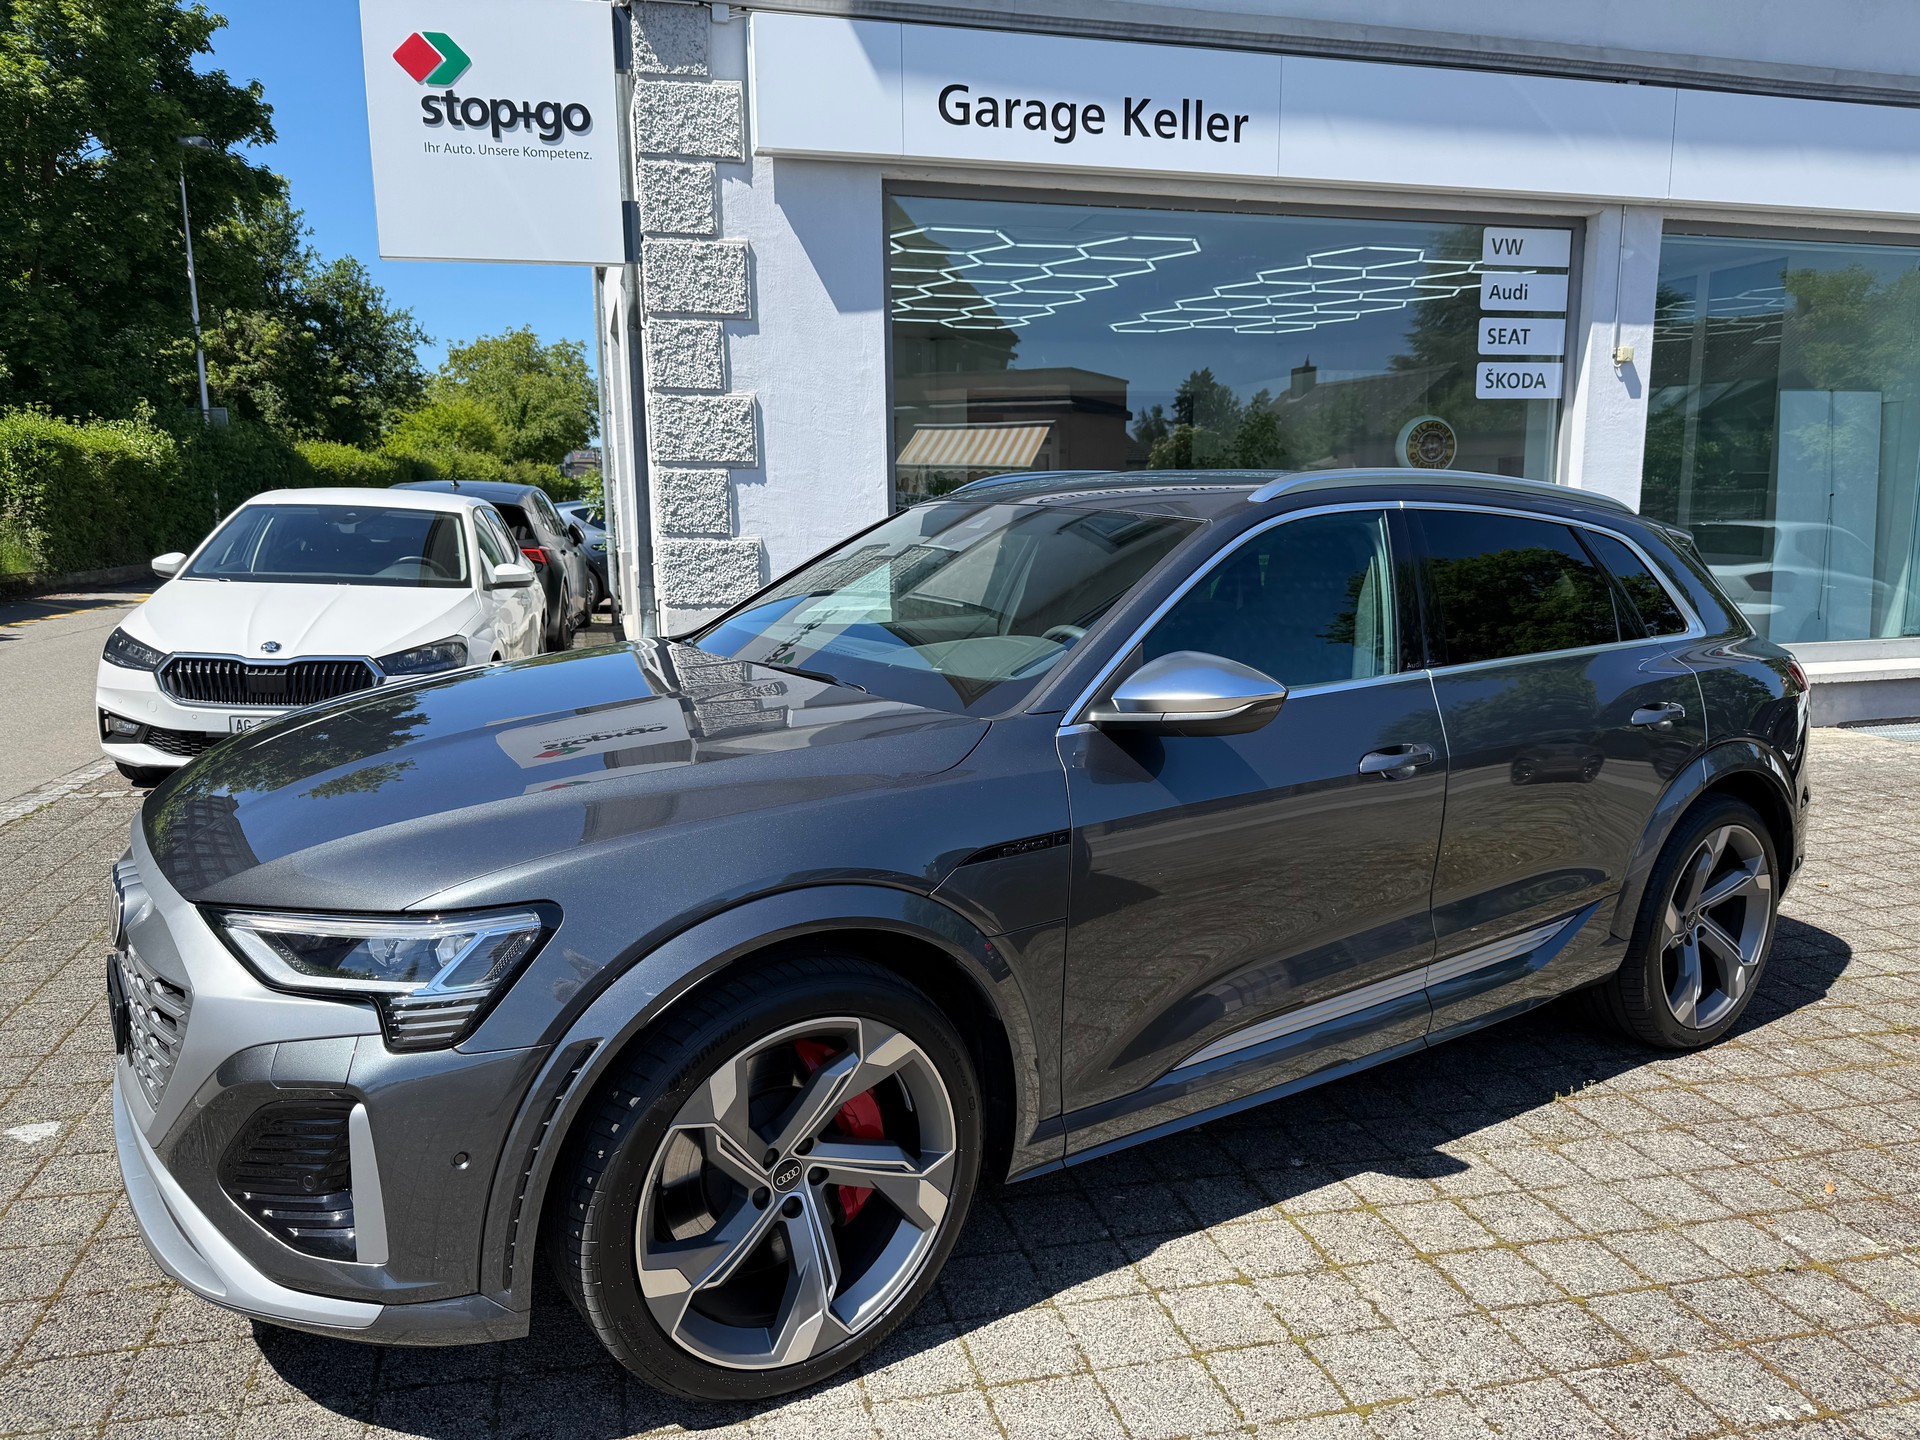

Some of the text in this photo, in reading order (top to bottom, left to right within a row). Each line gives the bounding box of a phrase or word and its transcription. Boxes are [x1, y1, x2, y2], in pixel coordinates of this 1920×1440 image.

[421, 89, 591, 142] stop+go
[938, 84, 1249, 144] Garage Keller
[424, 141, 593, 161] Ihr Auto. Unsere Kompetenz.
[1491, 237, 1524, 255] VW
[1489, 283, 1529, 301] Audi
[1487, 328, 1531, 345] SEAT
[1485, 369, 1547, 389] ŠKODA
[236, 719, 251, 731] AG
